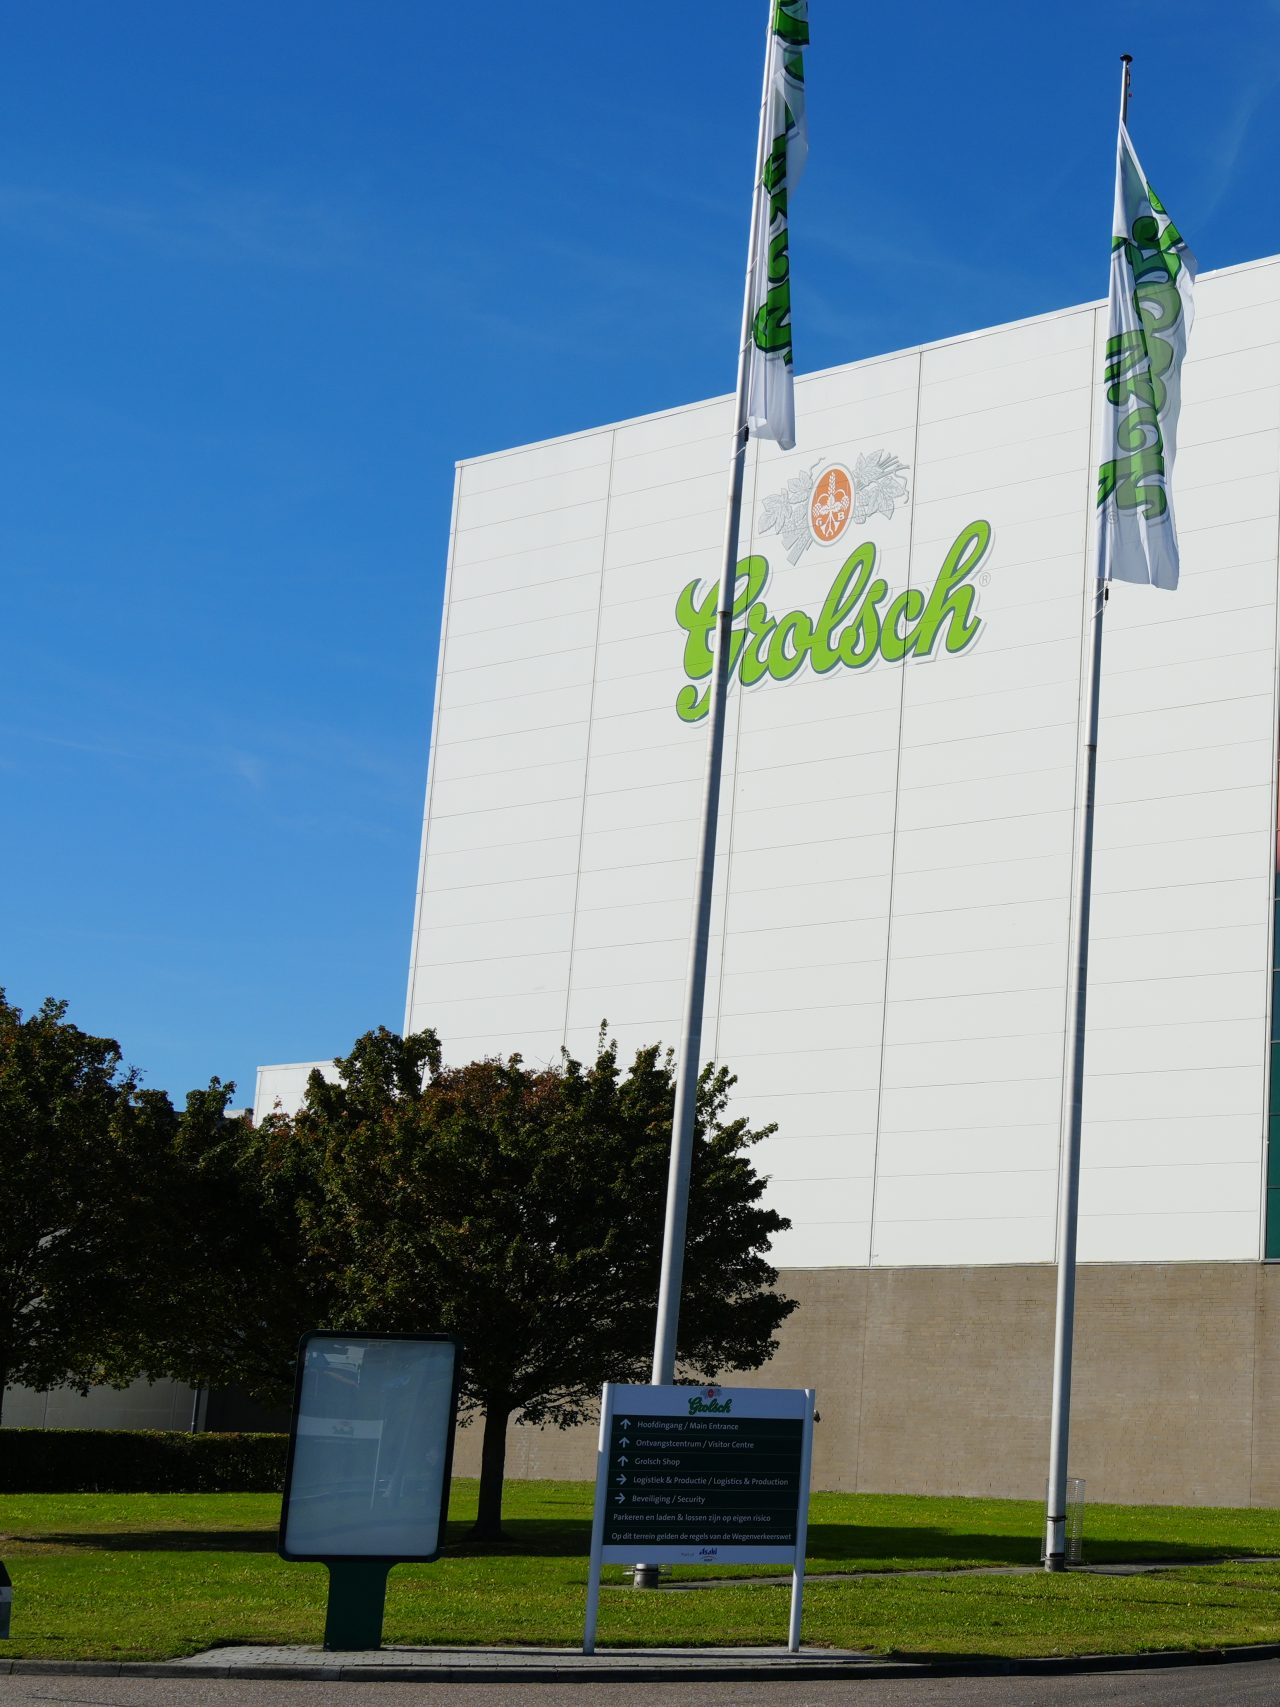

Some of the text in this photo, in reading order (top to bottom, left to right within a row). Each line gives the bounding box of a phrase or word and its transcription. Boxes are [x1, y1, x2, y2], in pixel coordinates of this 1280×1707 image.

[675, 520, 991, 723] Grolsch
[688, 1397, 733, 1415] Grolsch
[637, 1420, 683, 1431] Hoofdingang
[683, 1421, 688, 1430] /
[709, 1422, 738, 1430] Entrance
[702, 1440, 707, 1449] /
[708, 1440, 730, 1448] Visitor
[731, 1441, 754, 1449] Centre
[635, 1457, 680, 1467] Grolsch Shop
[633, 1476, 664, 1485] Logistiek
[665, 1476, 672, 1484] &
[674, 1476, 707, 1484] Productie
[708, 1476, 712, 1486] /
[713, 1477, 742, 1487] Logistics
[743, 1477, 750, 1485] &
[632, 1495, 705, 1505] Beveiliging / Security
[613, 1513, 644, 1521] Parkeren
[656, 1513, 675, 1521] laden
[677, 1513, 683, 1521] &
[685, 1513, 707, 1521] lossen
[708, 1513, 721, 1523] zijn
[722, 1515, 731, 1523] op
[732, 1514, 751, 1523] eigen
[753, 1514, 771, 1522] risico
[611, 1532, 622, 1541] Op
[622, 1532, 632, 1540] dit
[656, 1532, 678, 1542] gelden
[679, 1532, 688, 1540] de
[689, 1532, 708, 1542] regels
